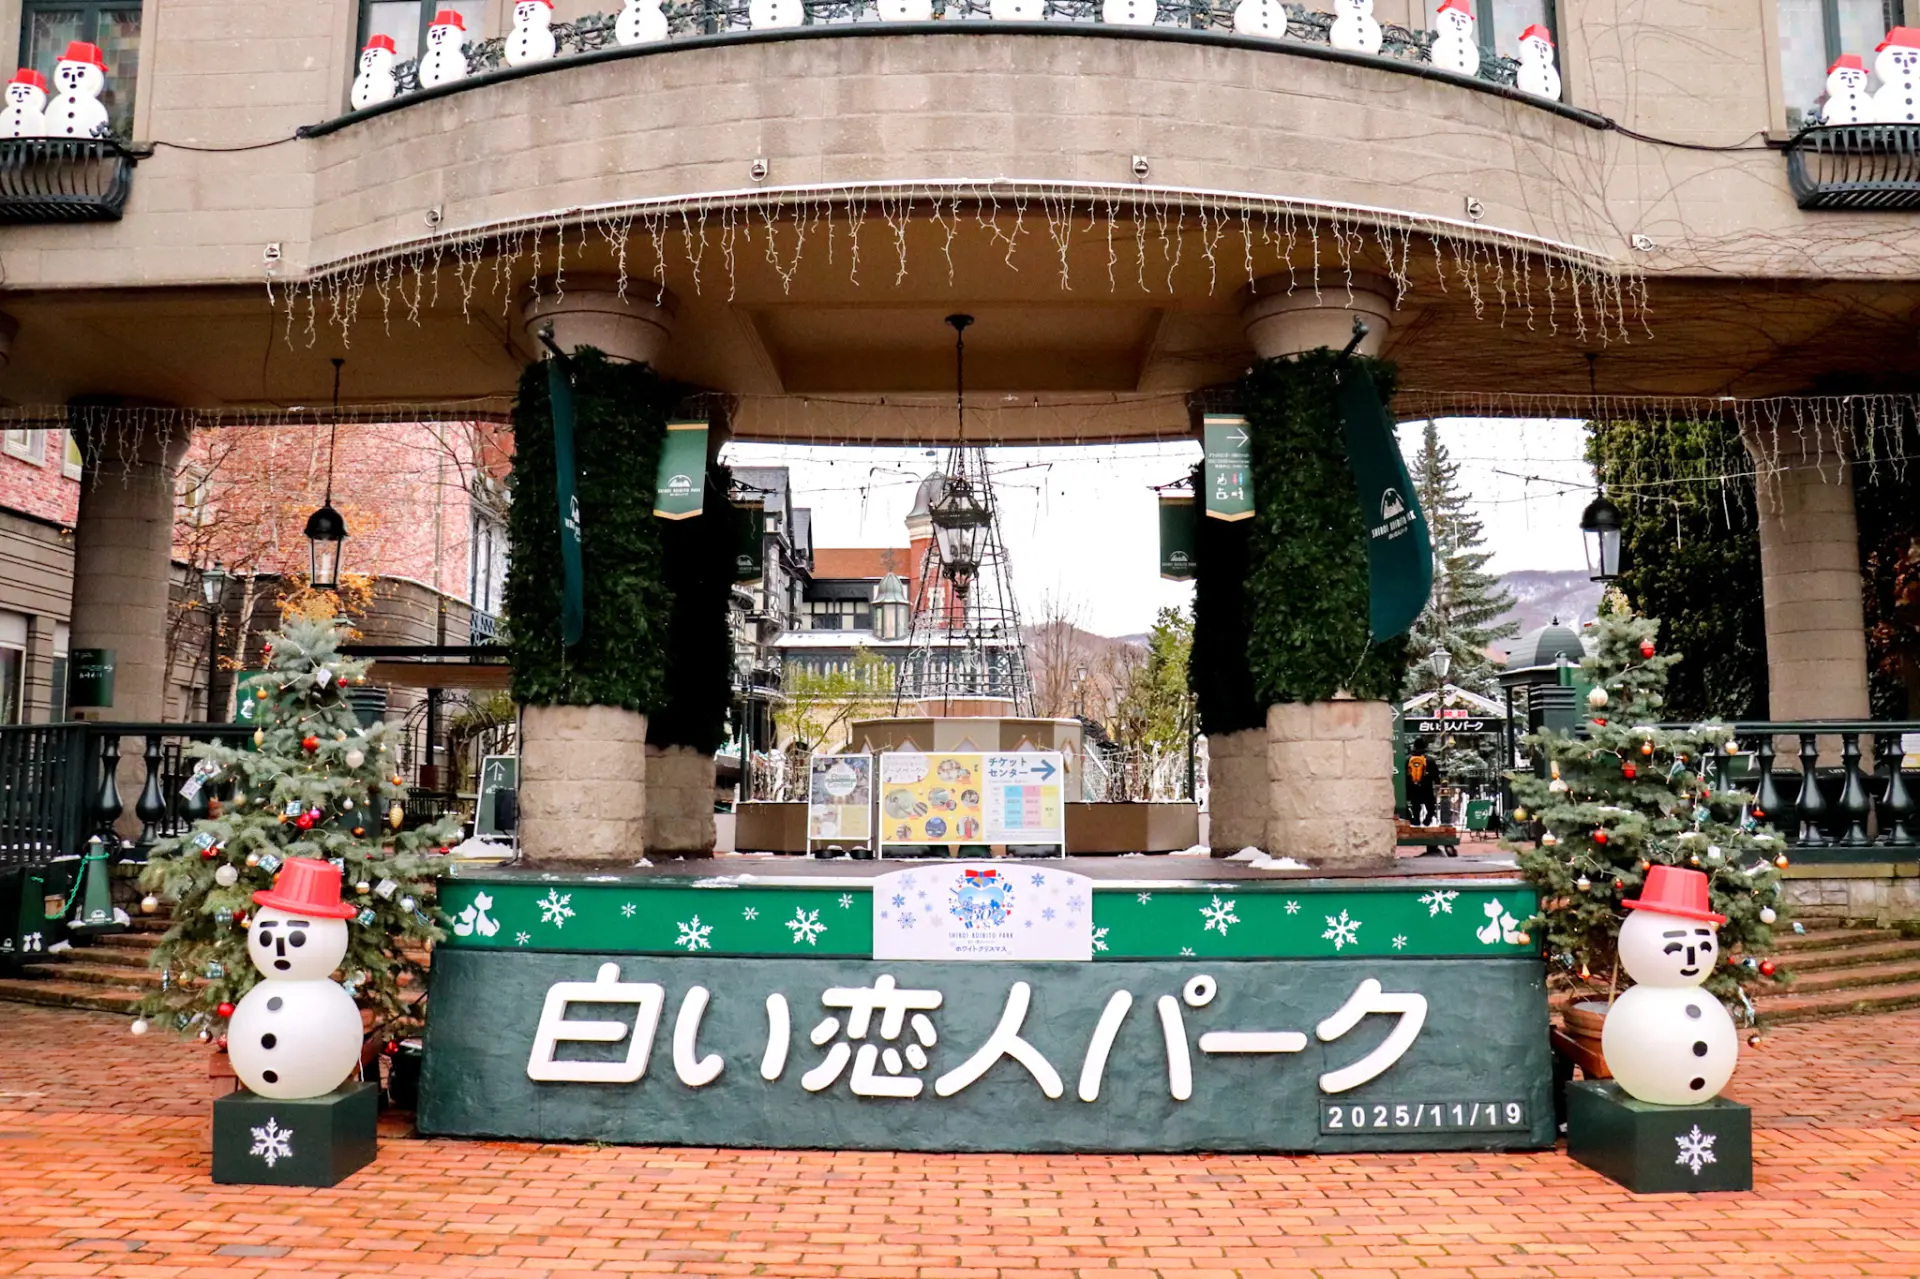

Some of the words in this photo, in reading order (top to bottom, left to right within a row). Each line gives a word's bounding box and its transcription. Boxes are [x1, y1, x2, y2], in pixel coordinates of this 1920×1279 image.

[988, 757, 1027, 767] チケット
[988, 768, 1029, 778] センター
[955, 945, 1007, 953] ホワイトクリスマス
[526, 964, 1428, 1102] 白い恋人パーク
[1328, 1103, 1521, 1128] 2025/11/19
